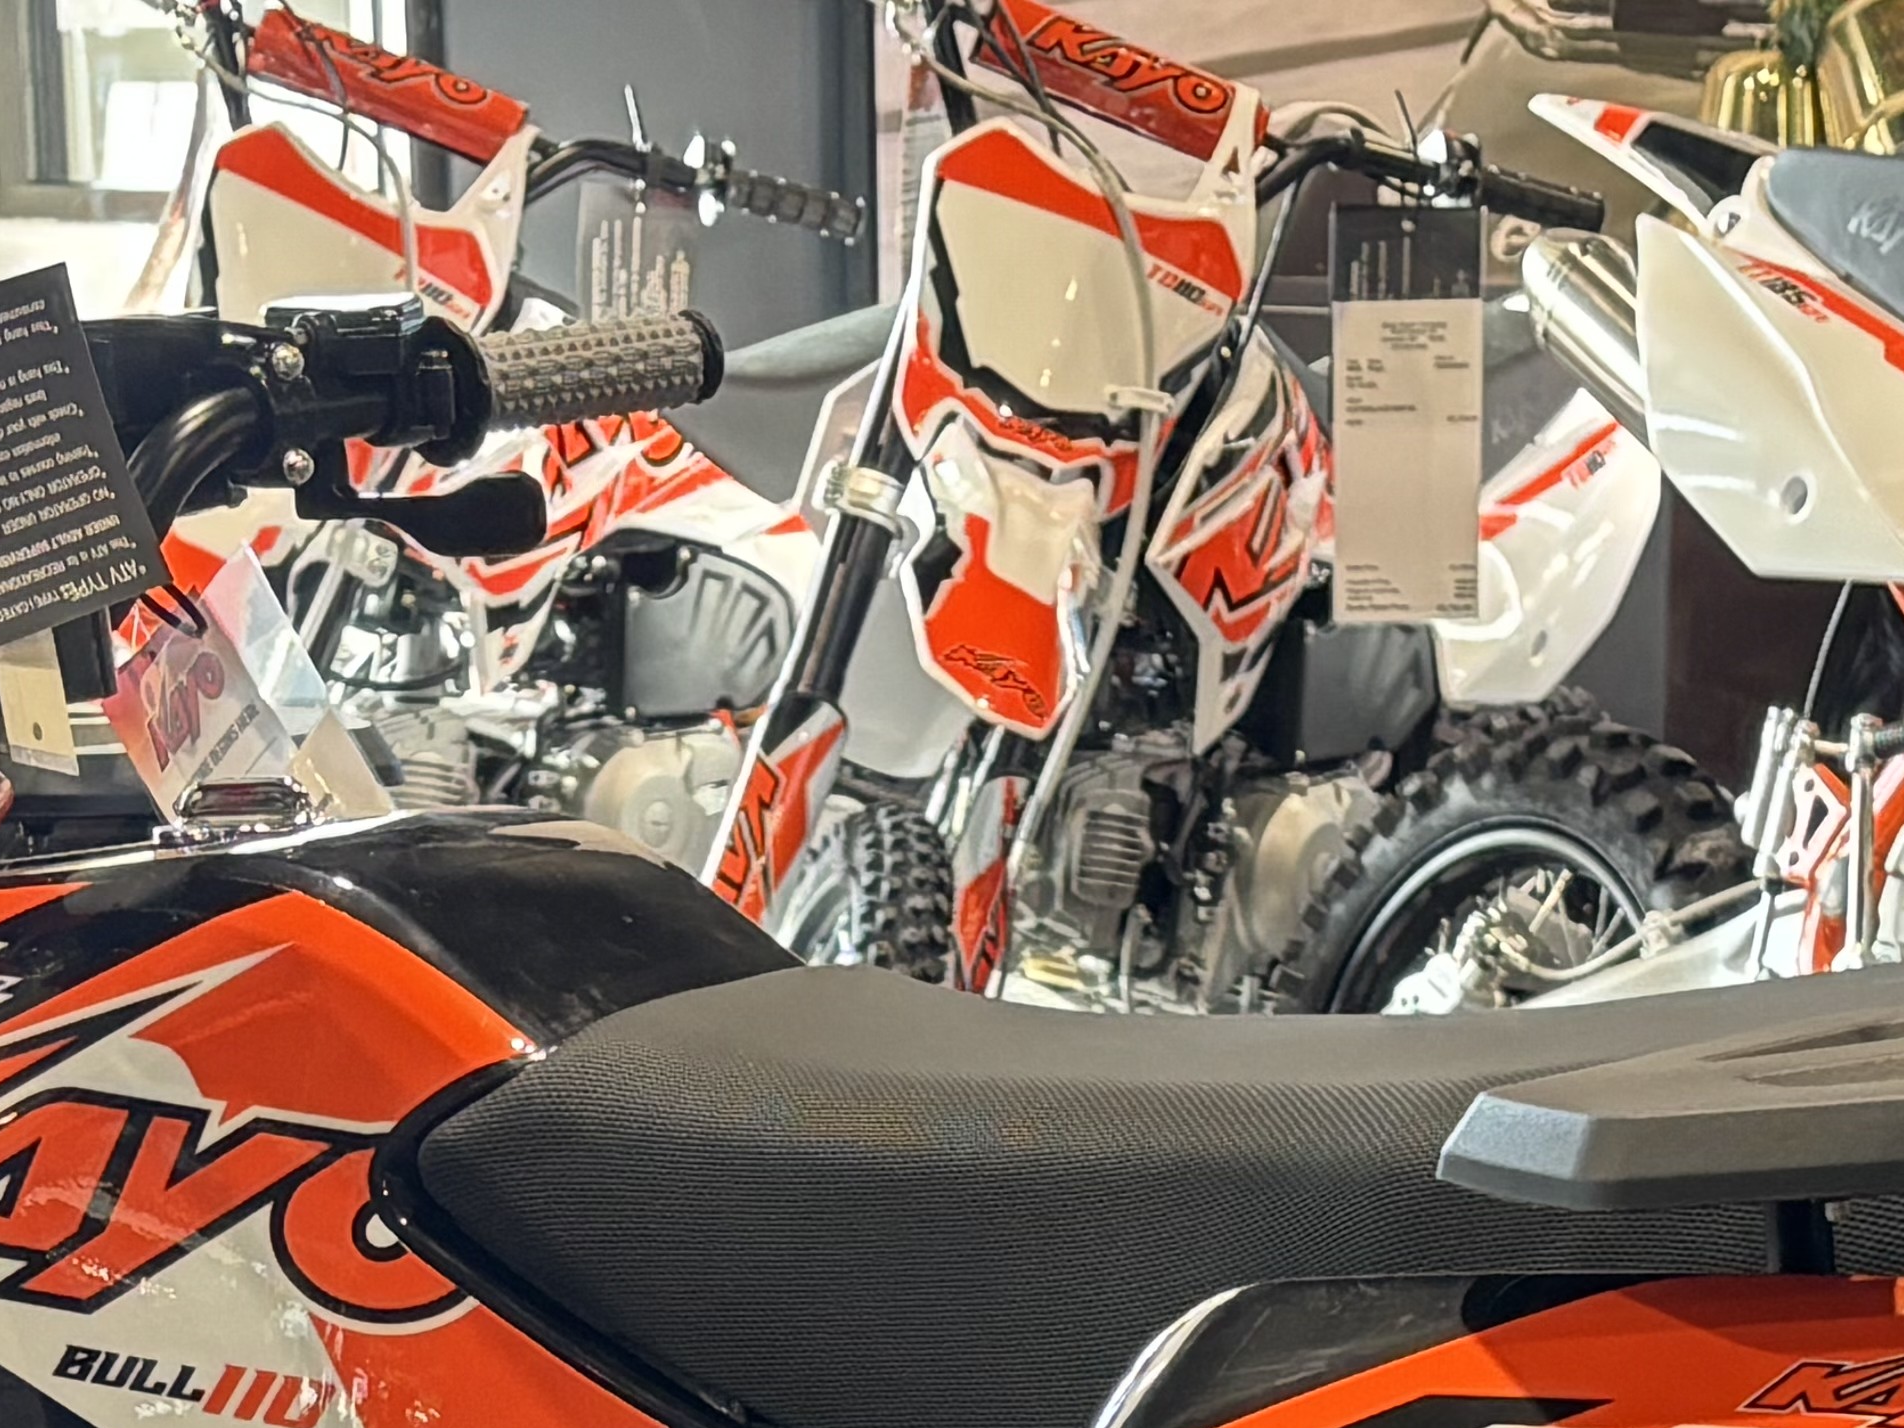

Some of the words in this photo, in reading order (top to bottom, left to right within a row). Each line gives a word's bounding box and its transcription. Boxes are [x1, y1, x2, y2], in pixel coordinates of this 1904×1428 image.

[89, 542, 109, 559] ATV
[108, 558, 137, 585] ATV
[52, 1344, 205, 1403] BULL
